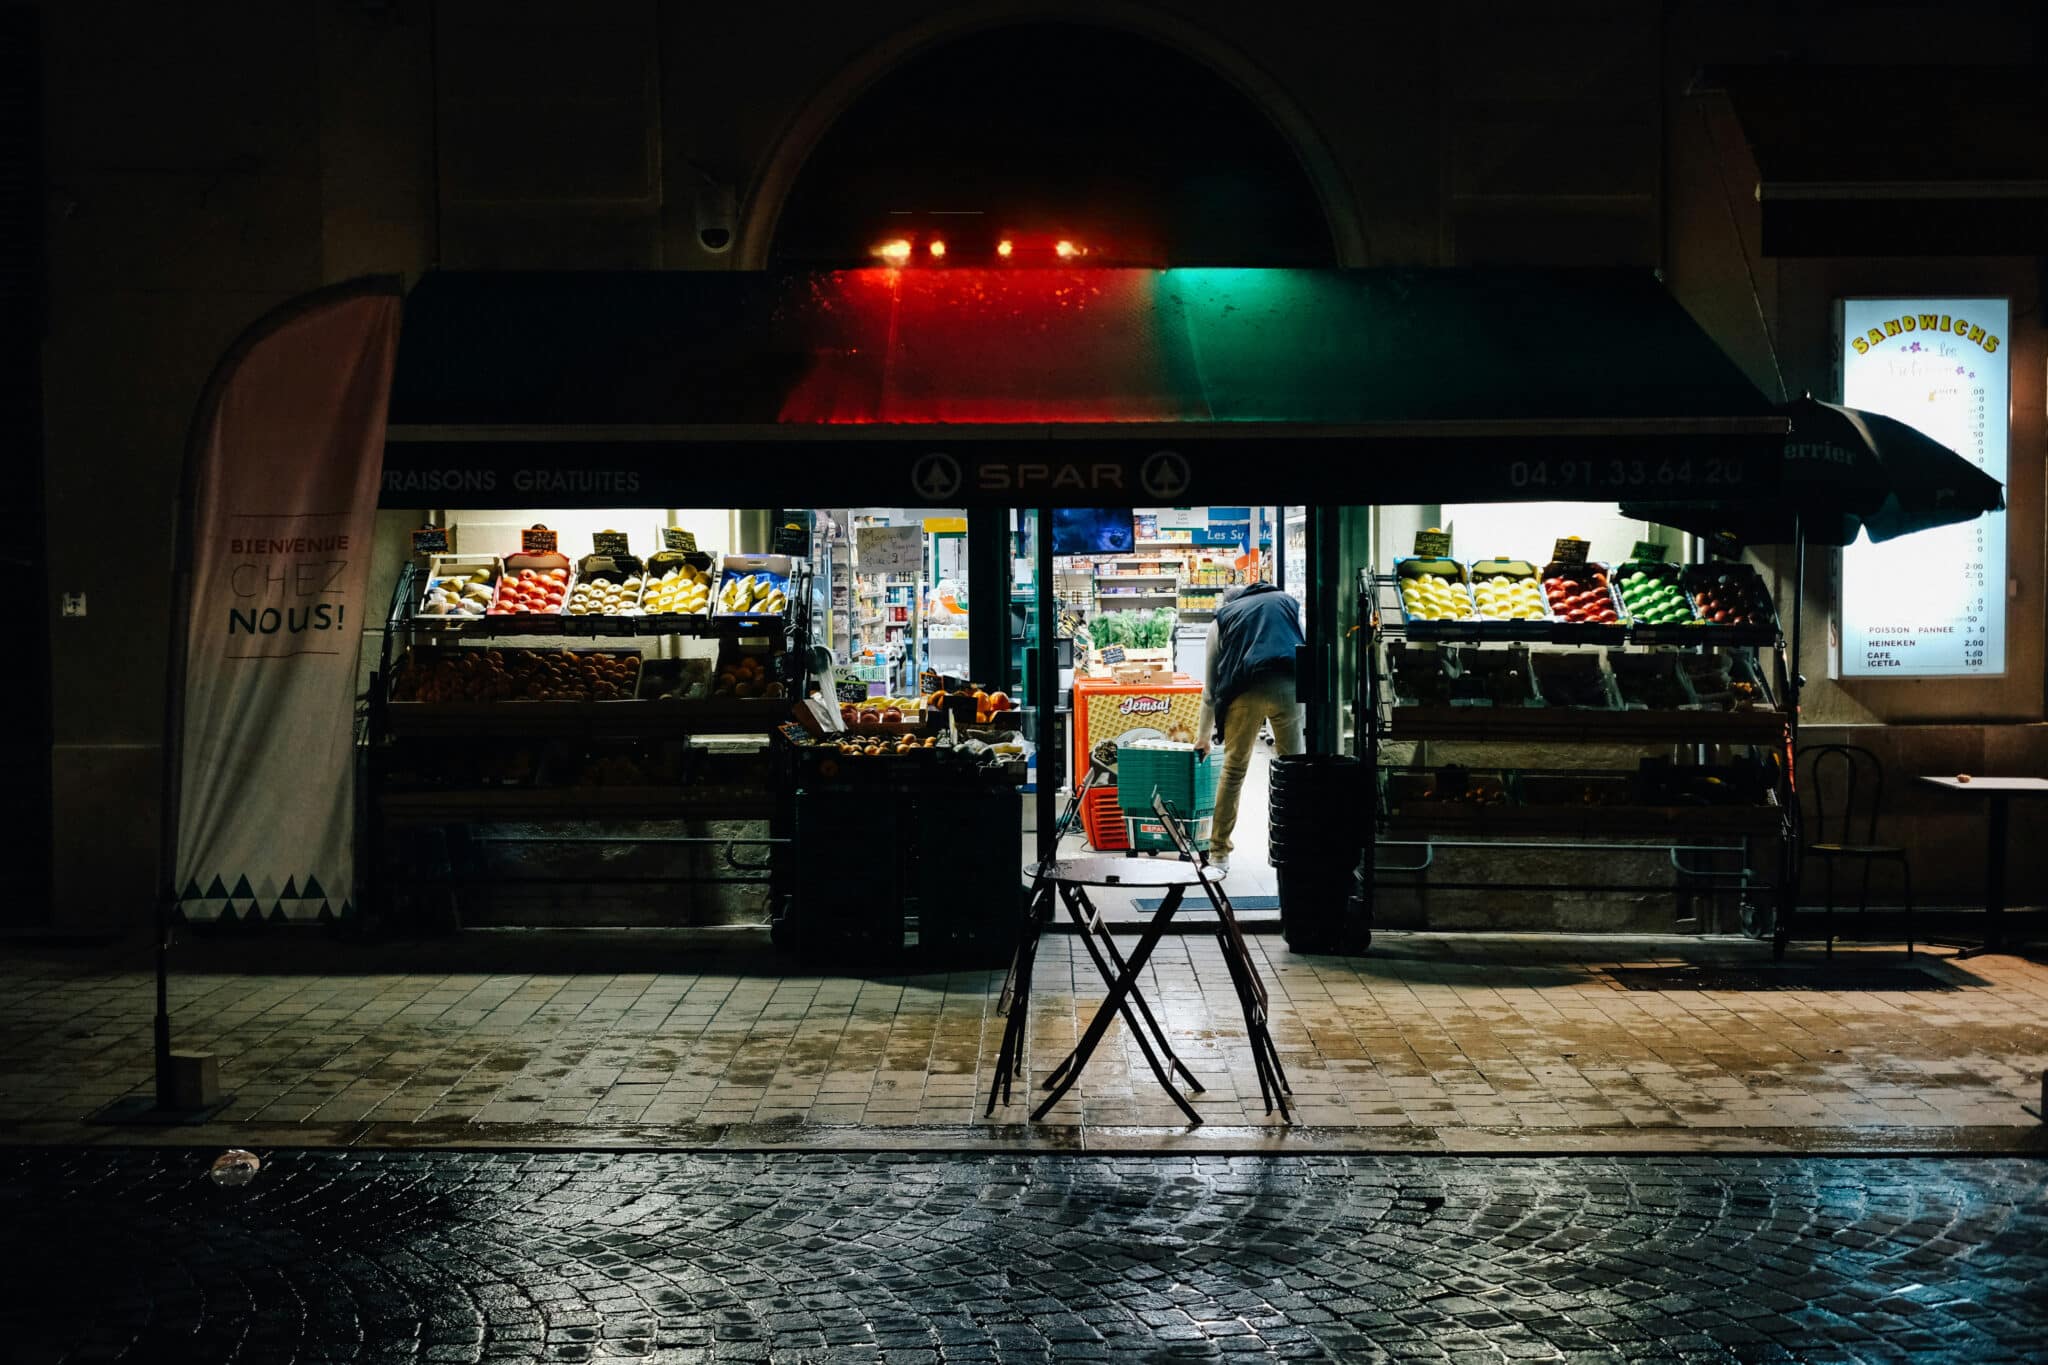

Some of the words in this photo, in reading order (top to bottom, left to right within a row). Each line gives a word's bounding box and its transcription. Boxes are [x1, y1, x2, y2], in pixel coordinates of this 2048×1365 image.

[1852, 314, 2000, 355] SANDWICHS
[1783, 440, 1857, 465] errier
[383, 469, 497, 492] RAISONS
[512, 470, 640, 492] GRATUITES
[976, 463, 1125, 489] SPAR
[231, 535, 349, 554] BIENVENUE
[1207, 529, 1226, 540] Les
[231, 560, 349, 598] CHEZ
[229, 603, 345, 635] NOUS!
[1868, 626, 1911, 634] POISSON
[1868, 640, 1916, 648] HEINEKEN
[1867, 659, 1901, 668] ICETEA
